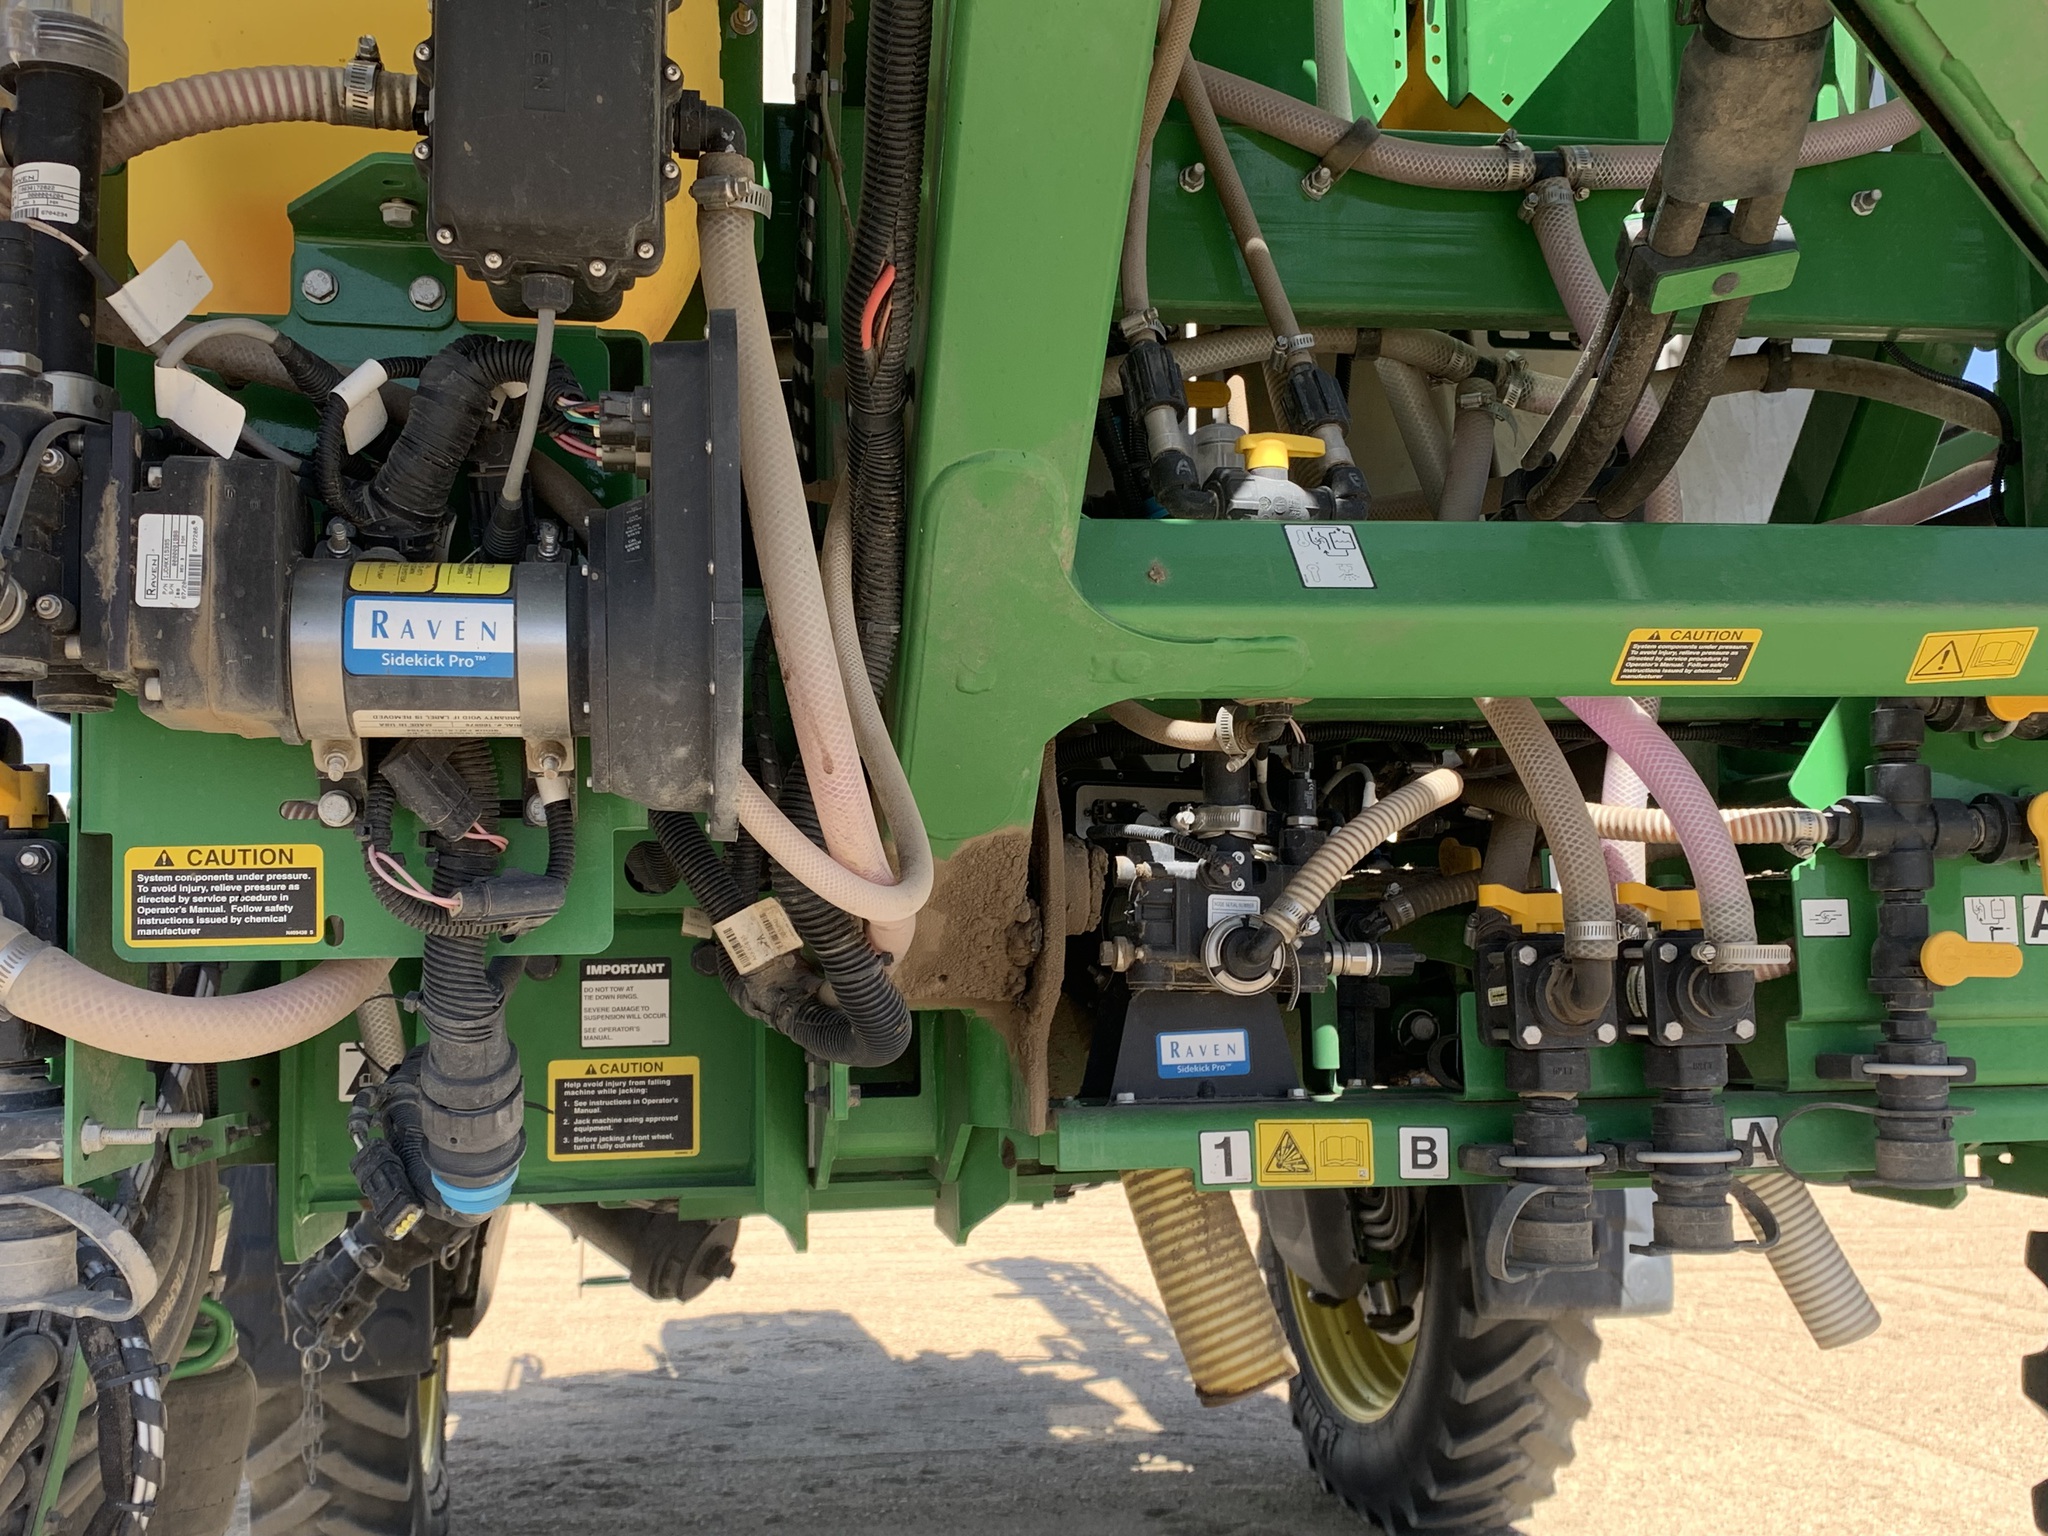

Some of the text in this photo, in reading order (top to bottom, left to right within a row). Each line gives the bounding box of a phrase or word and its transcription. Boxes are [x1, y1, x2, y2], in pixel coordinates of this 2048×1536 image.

[146, 559, 157, 595] RAVEN
[371, 610, 496, 641] RAVEN
[1670, 631, 1743, 640] CAUTION
[382, 653, 444, 667] Sidekick
[187, 848, 293, 866] CAUTION
[137, 874, 172, 882] System
[175, 873, 234, 882] components
[266, 873, 311, 881] pressure.
[151, 884, 177, 892] avoid
[179, 884, 208, 894] injury,
[245, 884, 286, 892] pressure
[178, 895, 190, 904] by
[229, 894, 277, 903] procedure
[137, 906, 187, 915] Operator's
[265, 904, 293, 913] safety
[137, 914, 287, 925] instructions issued by chemical
[137, 927, 200, 935] manufacturer
[586, 963, 665, 975] IMPORTANT
[1170, 1041, 1236, 1058] RAVEN
[600, 1062, 664, 1074] CAUTION
[1177, 1064, 1210, 1073] Sidekick
[1743, 1122, 1775, 1161] A
[1214, 1136, 1232, 1177] 1
[1411, 1136, 1438, 1170] B
